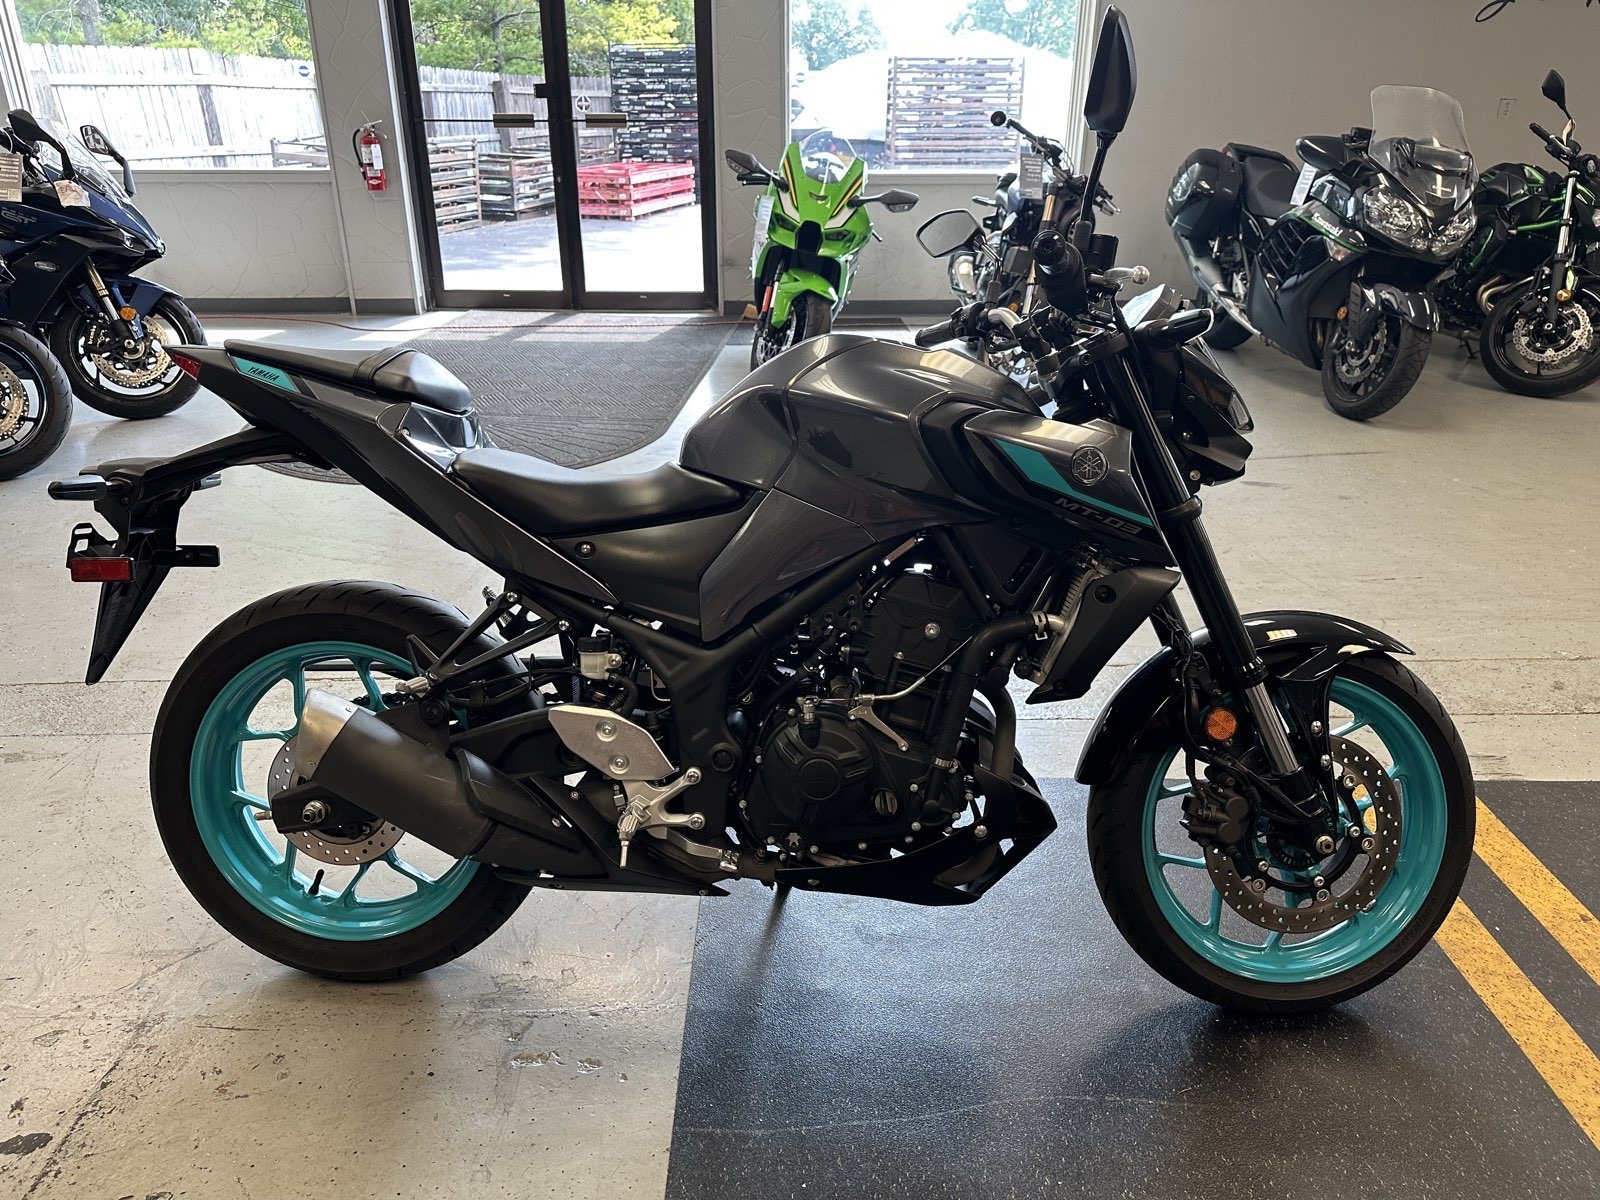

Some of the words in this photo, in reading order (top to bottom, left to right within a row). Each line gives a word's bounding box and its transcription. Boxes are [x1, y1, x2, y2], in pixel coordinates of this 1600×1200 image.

[1311, 212, 1344, 237] Kawasaki
[247, 366, 280, 382] YAMAHA
[1054, 497, 1144, 535] MT-03
